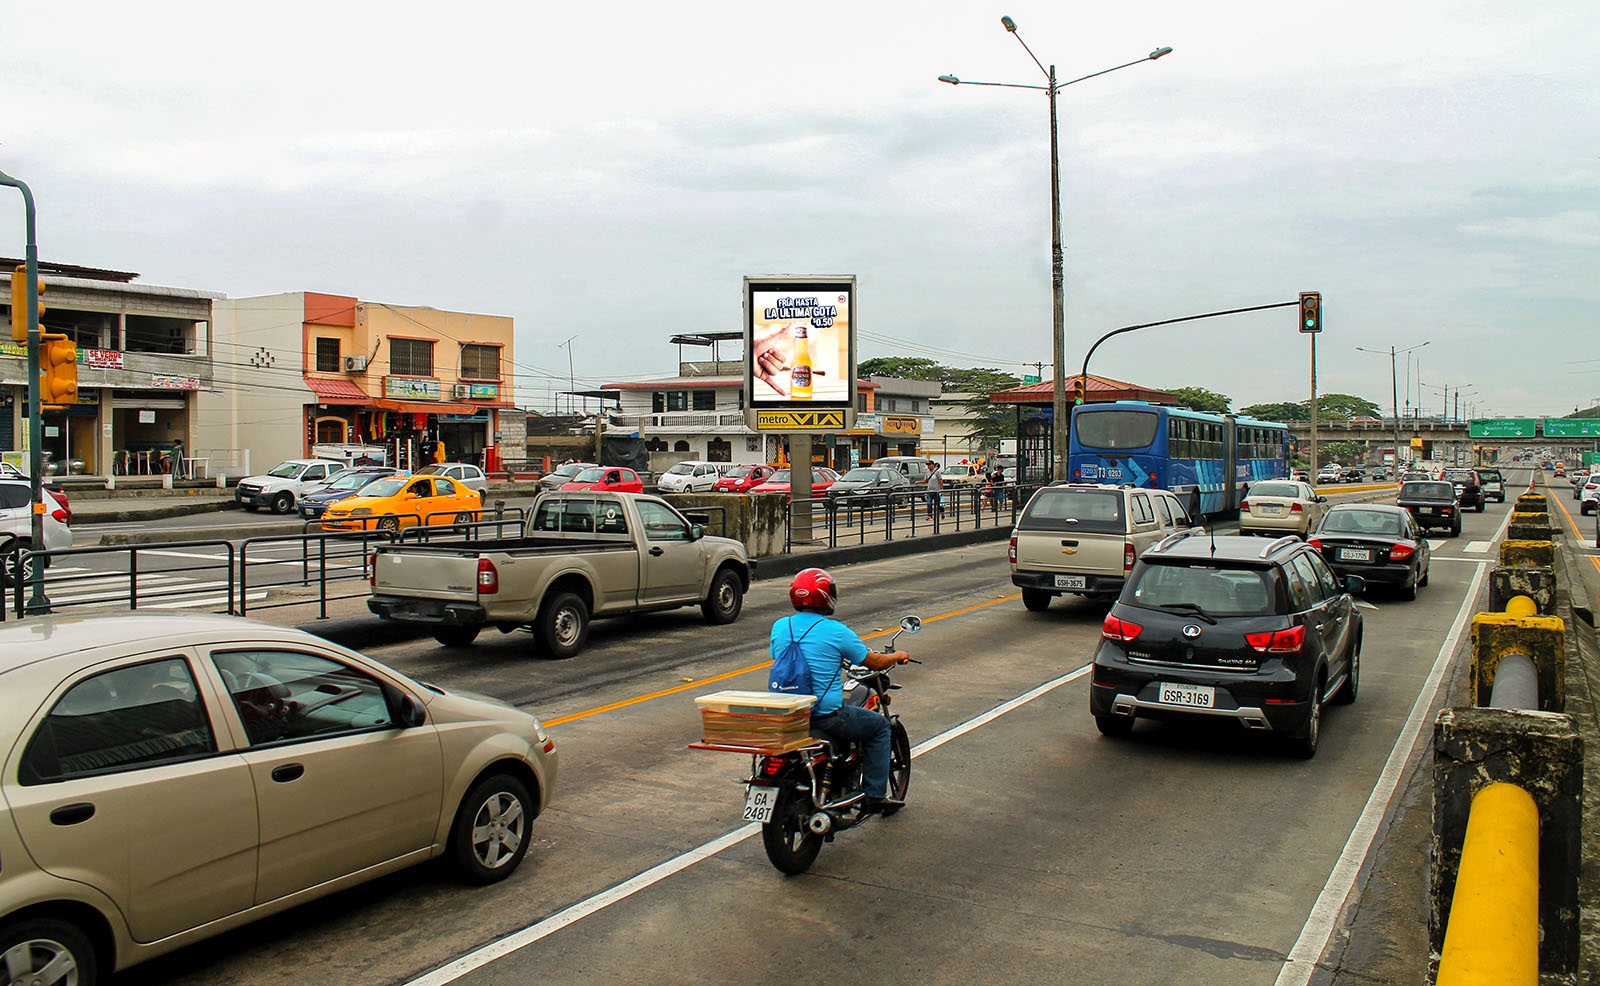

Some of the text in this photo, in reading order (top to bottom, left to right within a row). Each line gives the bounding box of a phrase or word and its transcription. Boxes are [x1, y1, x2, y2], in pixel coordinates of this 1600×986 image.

[777, 297, 819, 308] FRÍA HASTA
[765, 304, 837, 319] LA ÚLTIMA GOTA
[812, 317, 833, 327] $0.50
[90, 350, 99, 358] SE
[100, 350, 122, 359] VENDE
[759, 414, 789, 424] metro
[1098, 467, 1122, 478] T3 0203
[1164, 690, 1209, 706] GSR-3169
[754, 793, 768, 806] GA
[743, 806, 772, 821] 248T
